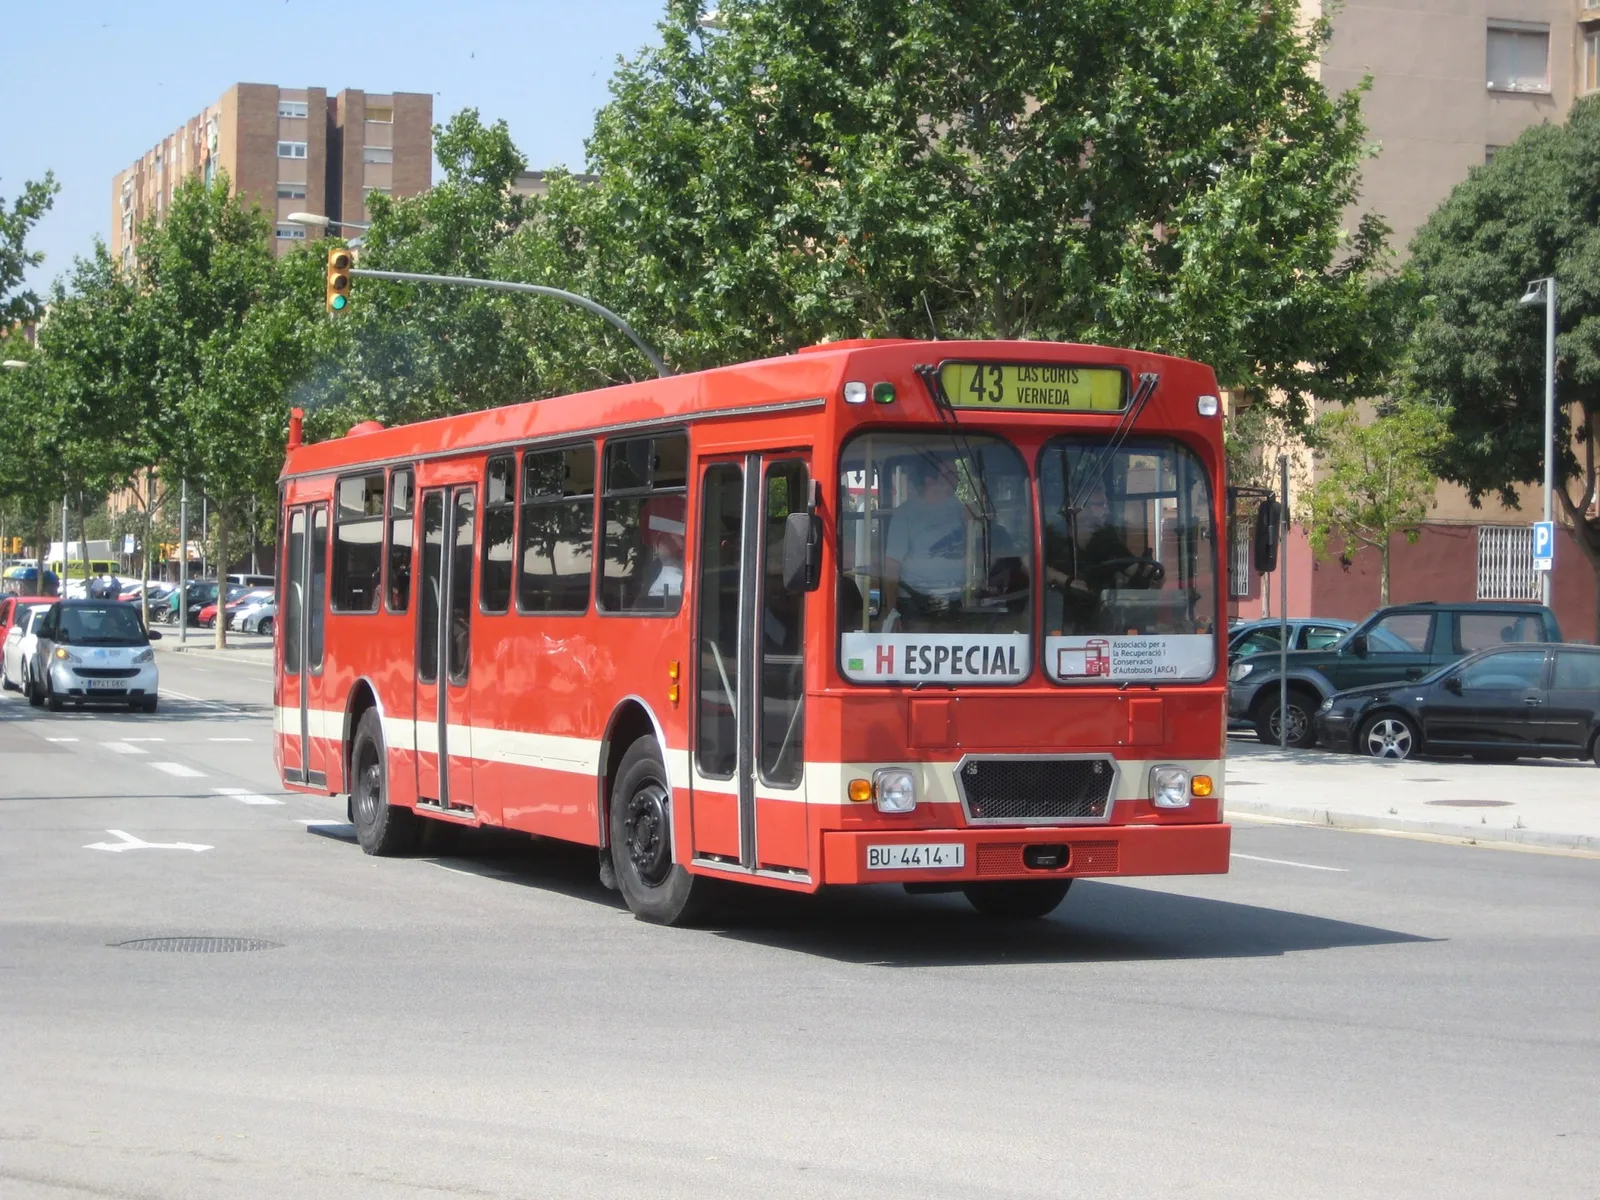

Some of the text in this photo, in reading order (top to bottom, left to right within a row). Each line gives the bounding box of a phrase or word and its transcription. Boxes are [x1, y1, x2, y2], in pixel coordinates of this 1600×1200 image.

[969, 365, 1004, 402] 43
[1017, 367, 1079, 384] LAS CORTS
[1016, 387, 1070, 406] VERNEDA
[1537, 527, 1549, 554] P
[1112, 640, 1147, 649] Associació
[1121, 649, 1162, 658] Recuperació
[876, 645, 1021, 675] H ESPECIAL
